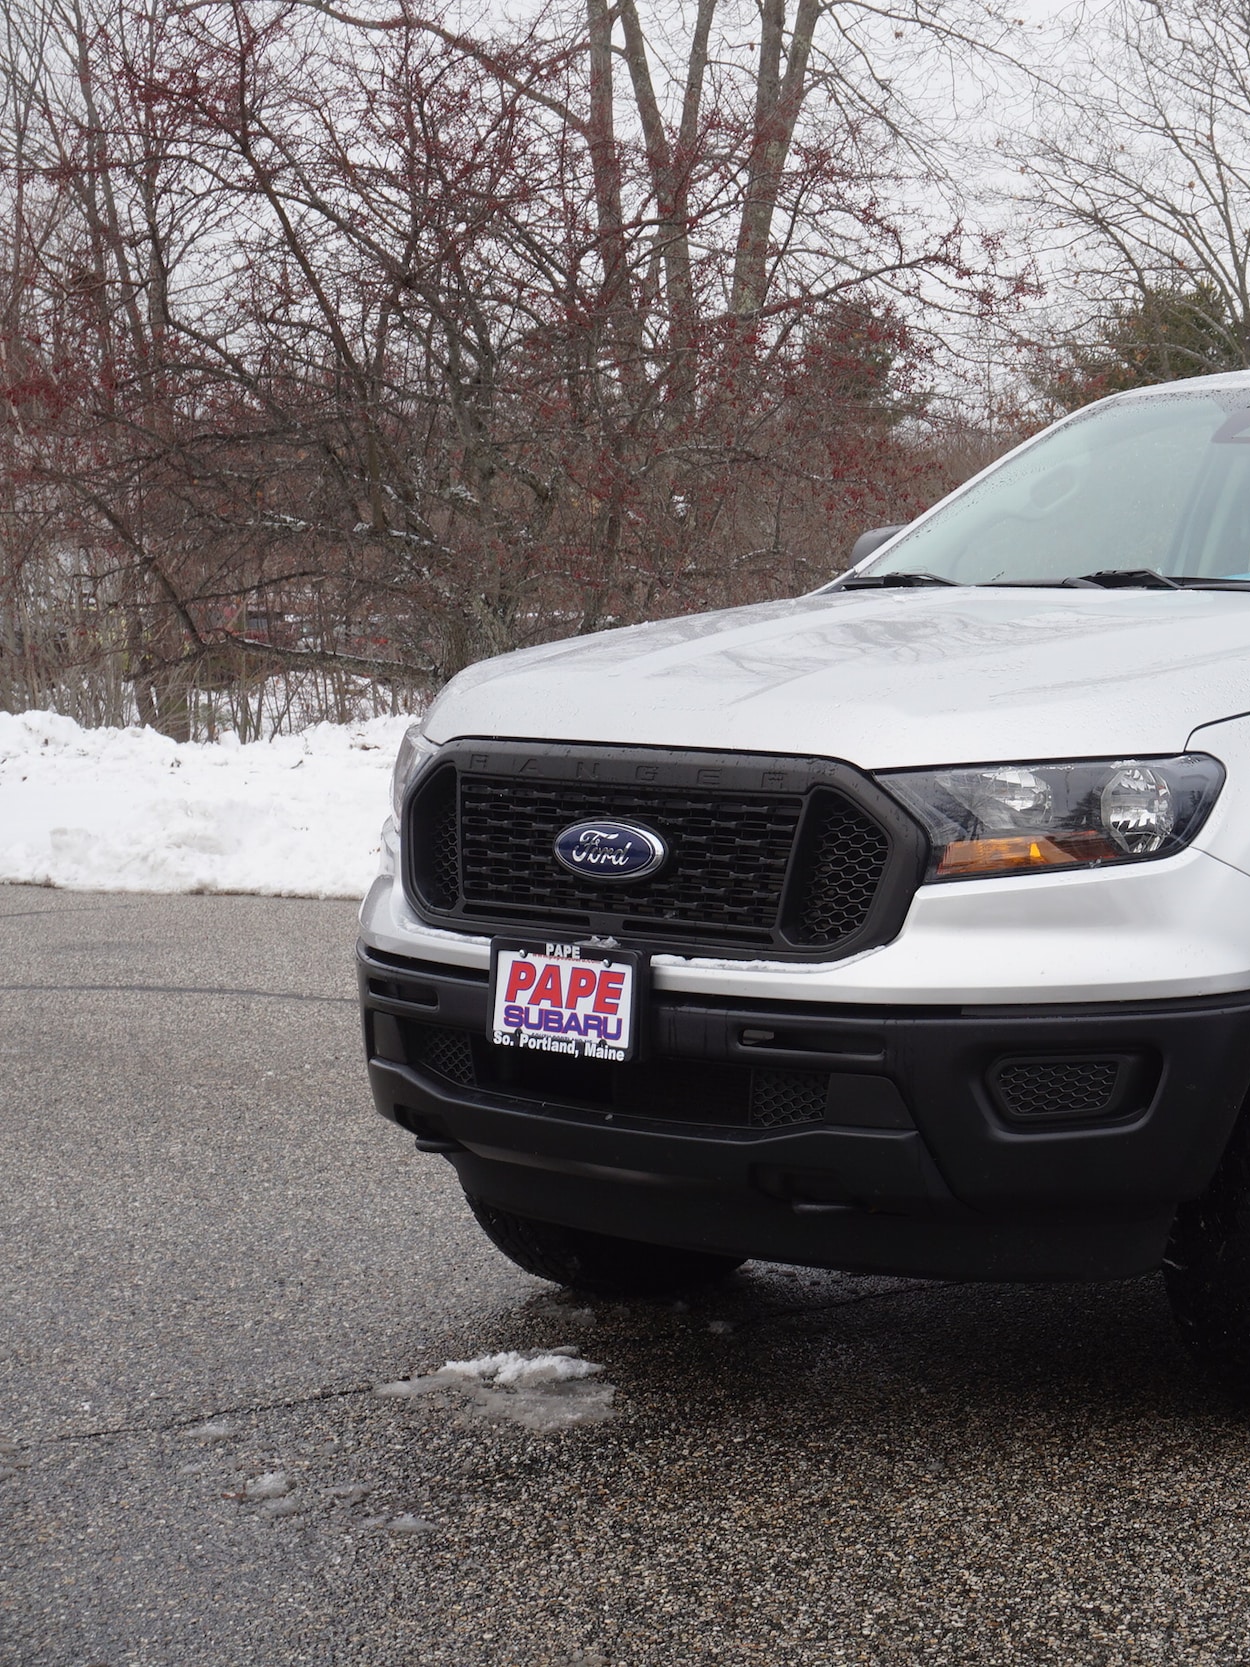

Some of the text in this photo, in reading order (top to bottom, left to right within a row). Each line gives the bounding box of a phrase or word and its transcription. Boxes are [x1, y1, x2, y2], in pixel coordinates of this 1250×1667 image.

[468, 753, 788, 790] RANGER
[572, 829, 631, 866] Ford
[545, 942, 581, 960] PAPE
[504, 959, 626, 1016] PAPE
[503, 1004, 624, 1041] SUBARU
[492, 1029, 515, 1047] So.
[518, 1032, 580, 1059] Portland,
[583, 1041, 626, 1063] Maine
